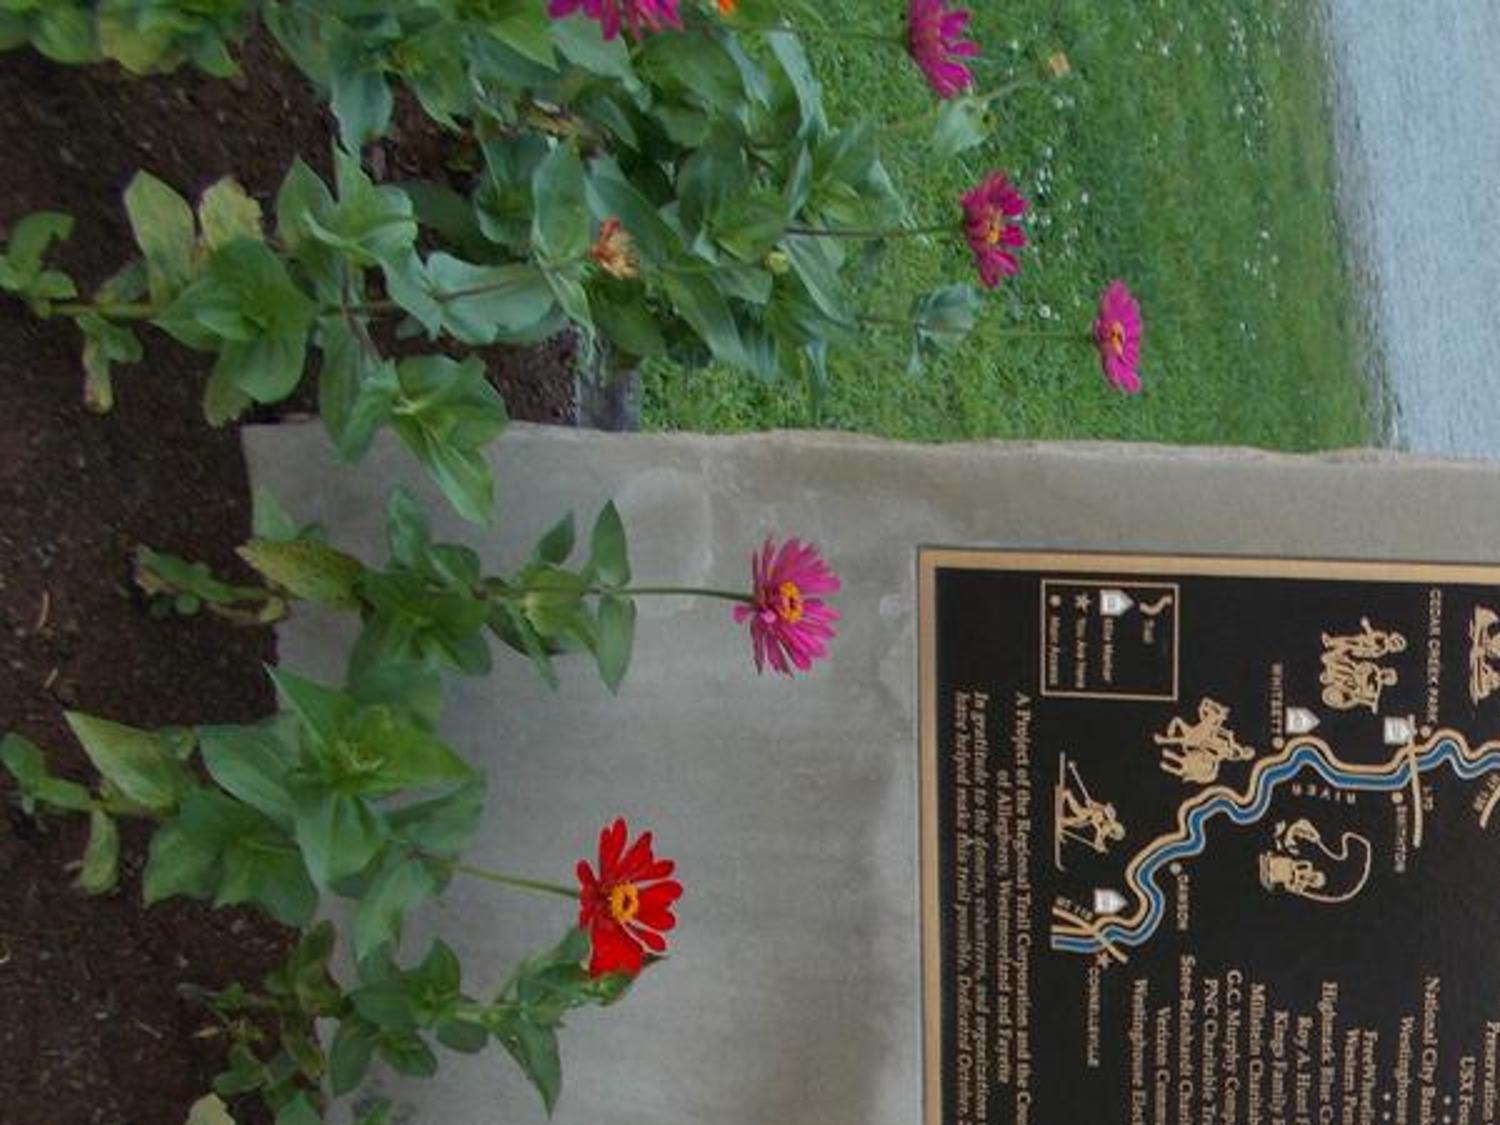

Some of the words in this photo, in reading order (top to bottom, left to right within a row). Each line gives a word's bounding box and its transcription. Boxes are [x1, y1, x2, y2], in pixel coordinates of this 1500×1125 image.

[1428, 589, 1442, 635] CEDAR
[1427, 639, 1441, 686] CREEK
[1017, 691, 1030, 706] A
[1426, 688, 1439, 723] PARK
[1012, 710, 1031, 766] Project
[997, 770, 1010, 788] of
[1017, 770, 1030, 787] of
[1017, 789, 1030, 816] the
[1013, 819, 1031, 889] Regional
[1017, 893, 1031, 930] Trail
[998, 880, 1011, 991] Westmoreland
[1013, 933, 1031, 1027] Corporation
[1203, 978, 1218, 1016] PNC
[998, 995, 1011, 1023] and
[1317, 981, 1338, 1063] Highmark
[1422, 977, 1440, 1045] National
[1017, 1031, 1031, 1059] and
[1128, 979, 1148, 1087] Westinghouse
[1222, 1009, 1241, 1072] Murphy
[1293, 1016, 1313, 1049] Roy
[994, 1028, 1011, 1083] Fayette
[1017, 1062, 1031, 1088] the
[1202, 1019, 1217, 1101] Charitable
[1297, 1051, 1311, 1068] A.
[1343, 1028, 1359, 1091] Western
[1394, 1016, 1415, 1124] Westinghouse
[1418, 1048, 1437, 1083] City
[1460, 1056, 1476, 1093] USX
[1483, 1021, 1500, 1120] Preservation
[1269, 1061, 1287, 1114] Family
[1296, 1073, 1311, 1113] Hunt
[1319, 1067, 1335, 1102] Blue
